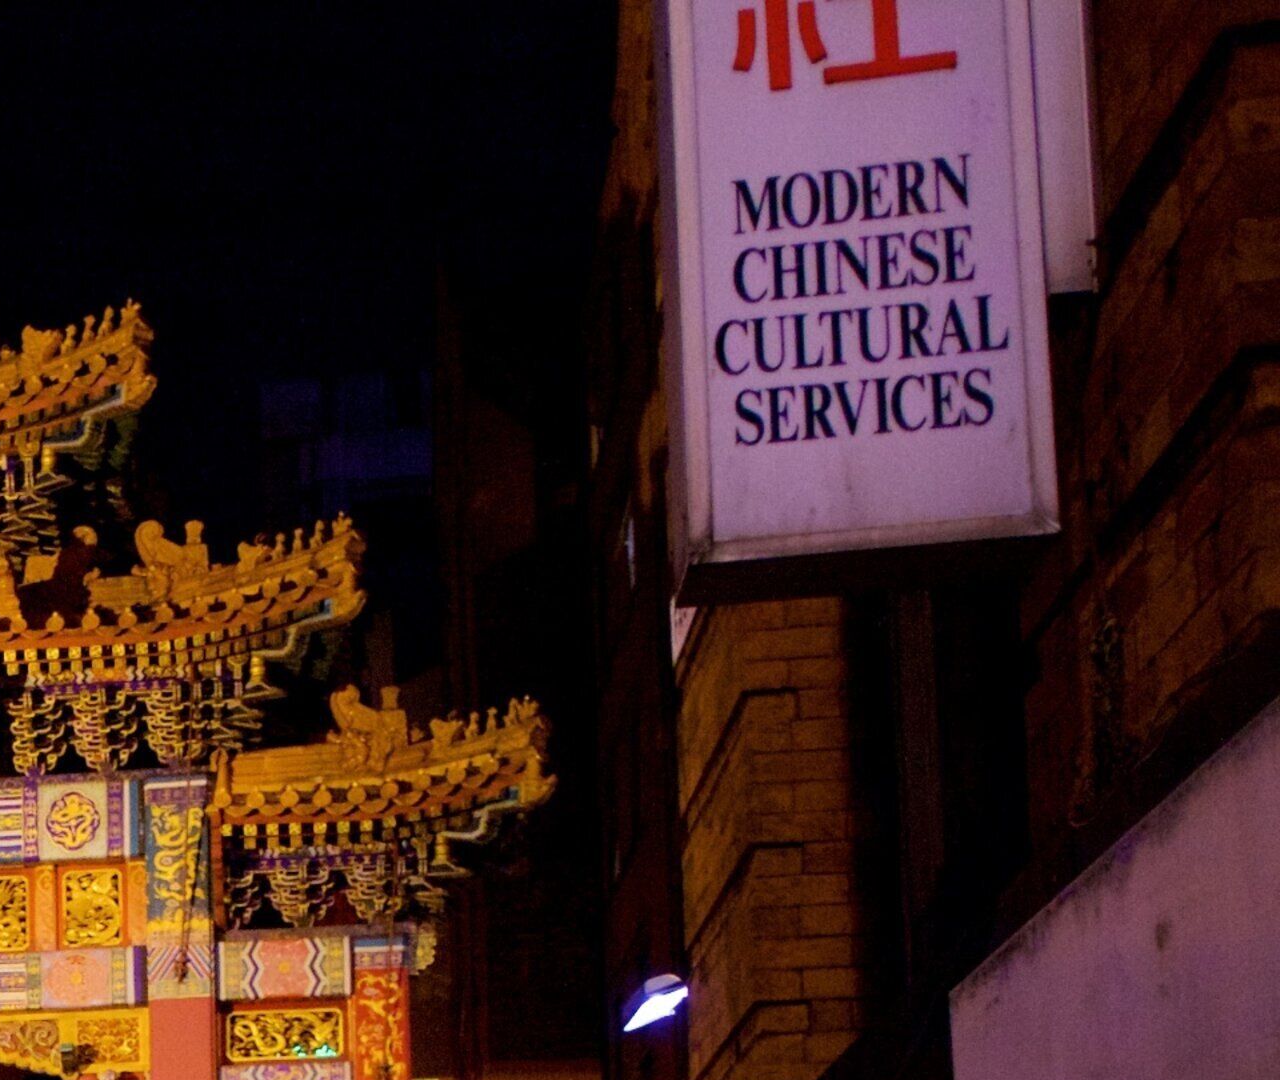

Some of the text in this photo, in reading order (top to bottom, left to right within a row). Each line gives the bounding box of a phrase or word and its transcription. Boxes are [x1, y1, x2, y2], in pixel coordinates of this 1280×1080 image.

[731, 153, 972, 235] MODERN
[731, 226, 976, 303] CHINESE
[714, 294, 1009, 376] CULTURAL
[734, 368, 995, 447] SERVICES
